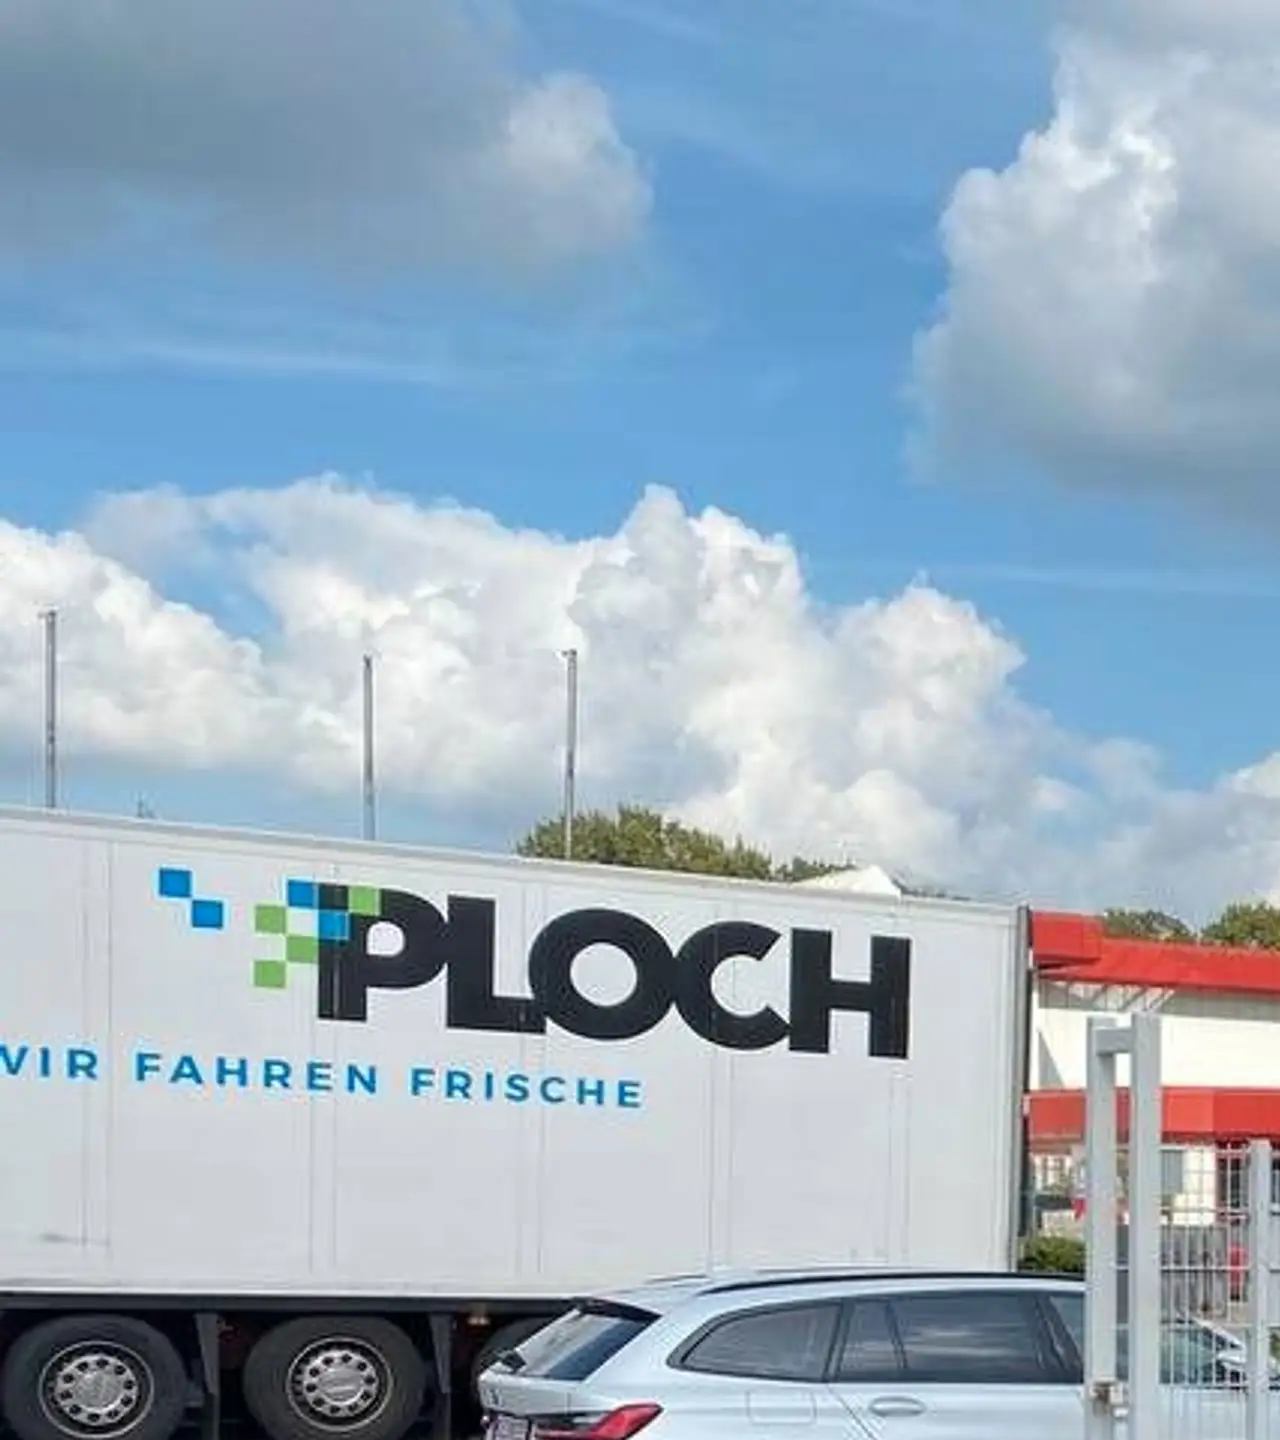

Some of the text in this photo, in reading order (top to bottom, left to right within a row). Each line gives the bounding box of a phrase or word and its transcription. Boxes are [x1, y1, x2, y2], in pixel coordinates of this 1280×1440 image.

[317, 883, 911, 1060] PLOCH
[135, 1051, 377, 1094] FAHREN
[411, 1068, 642, 1108] FRISCHE
